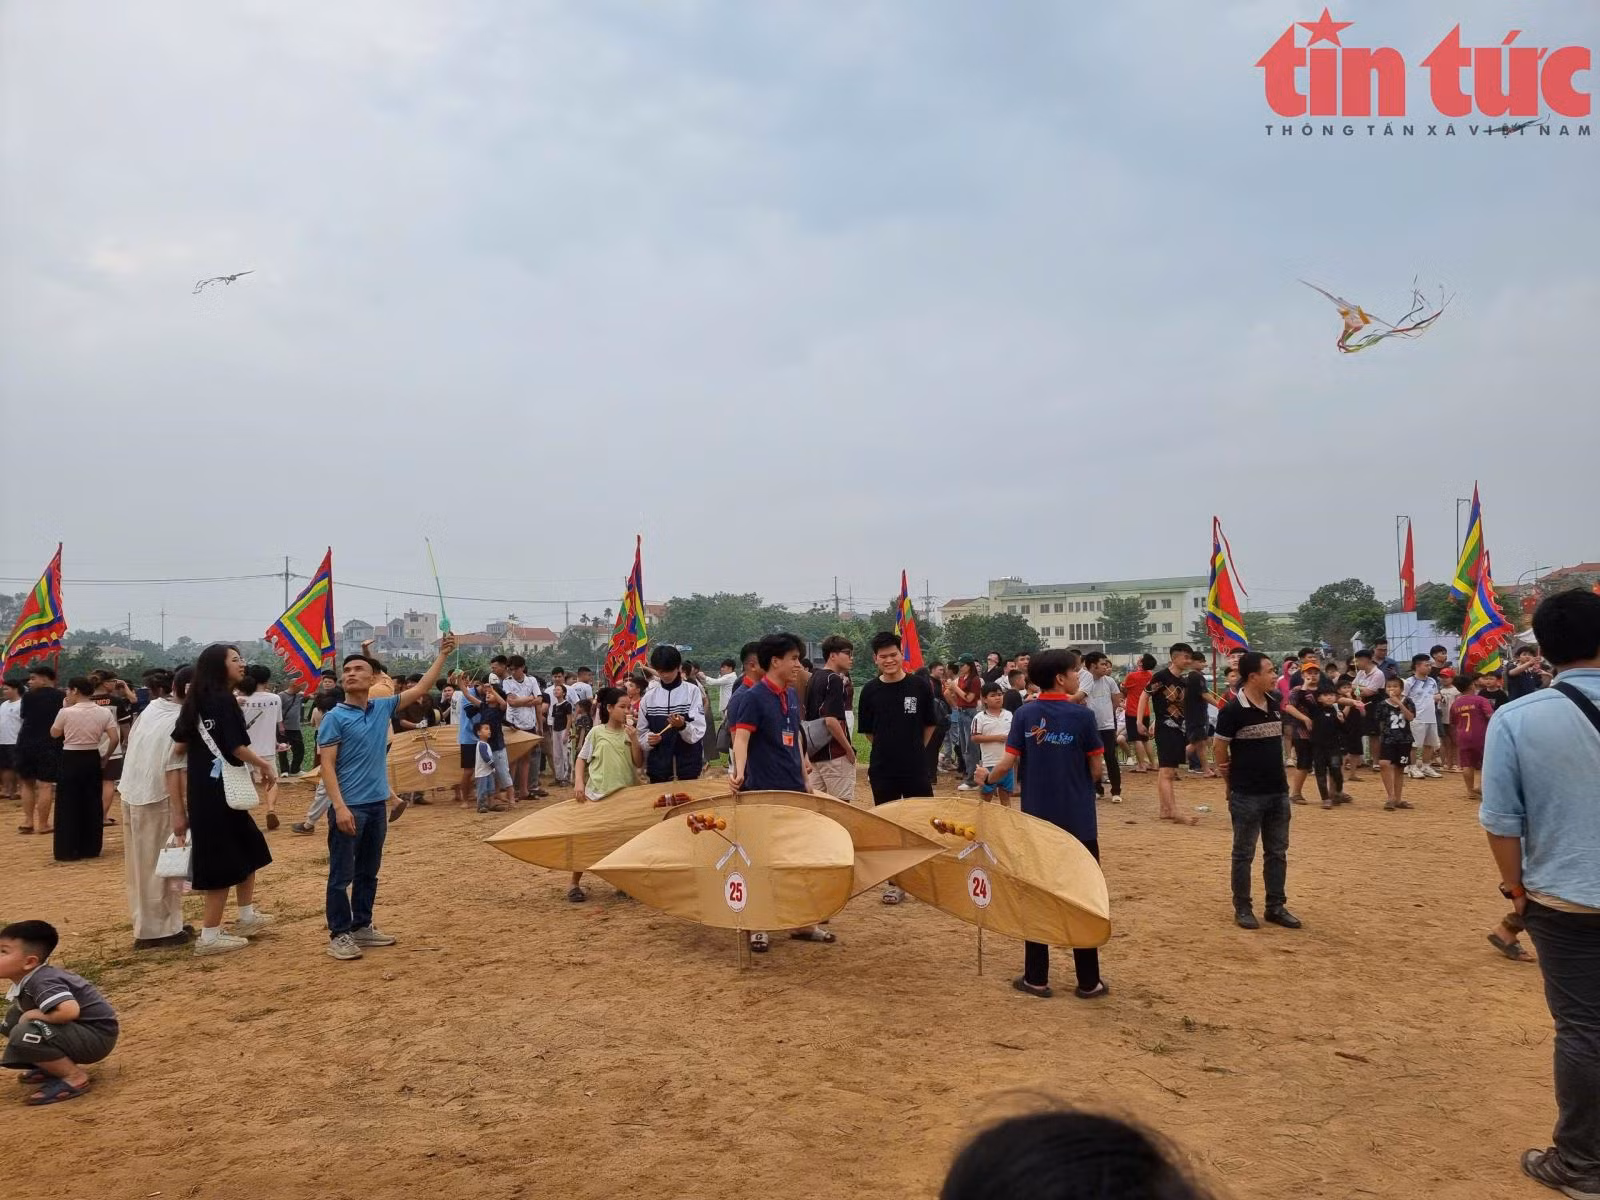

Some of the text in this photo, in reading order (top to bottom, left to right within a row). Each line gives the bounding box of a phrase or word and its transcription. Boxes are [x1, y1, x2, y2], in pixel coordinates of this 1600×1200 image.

[1461, 712, 1471, 733] 7
[422, 761, 433, 771] 03
[730, 881, 743, 902] 25
[972, 876, 987, 899] 24
